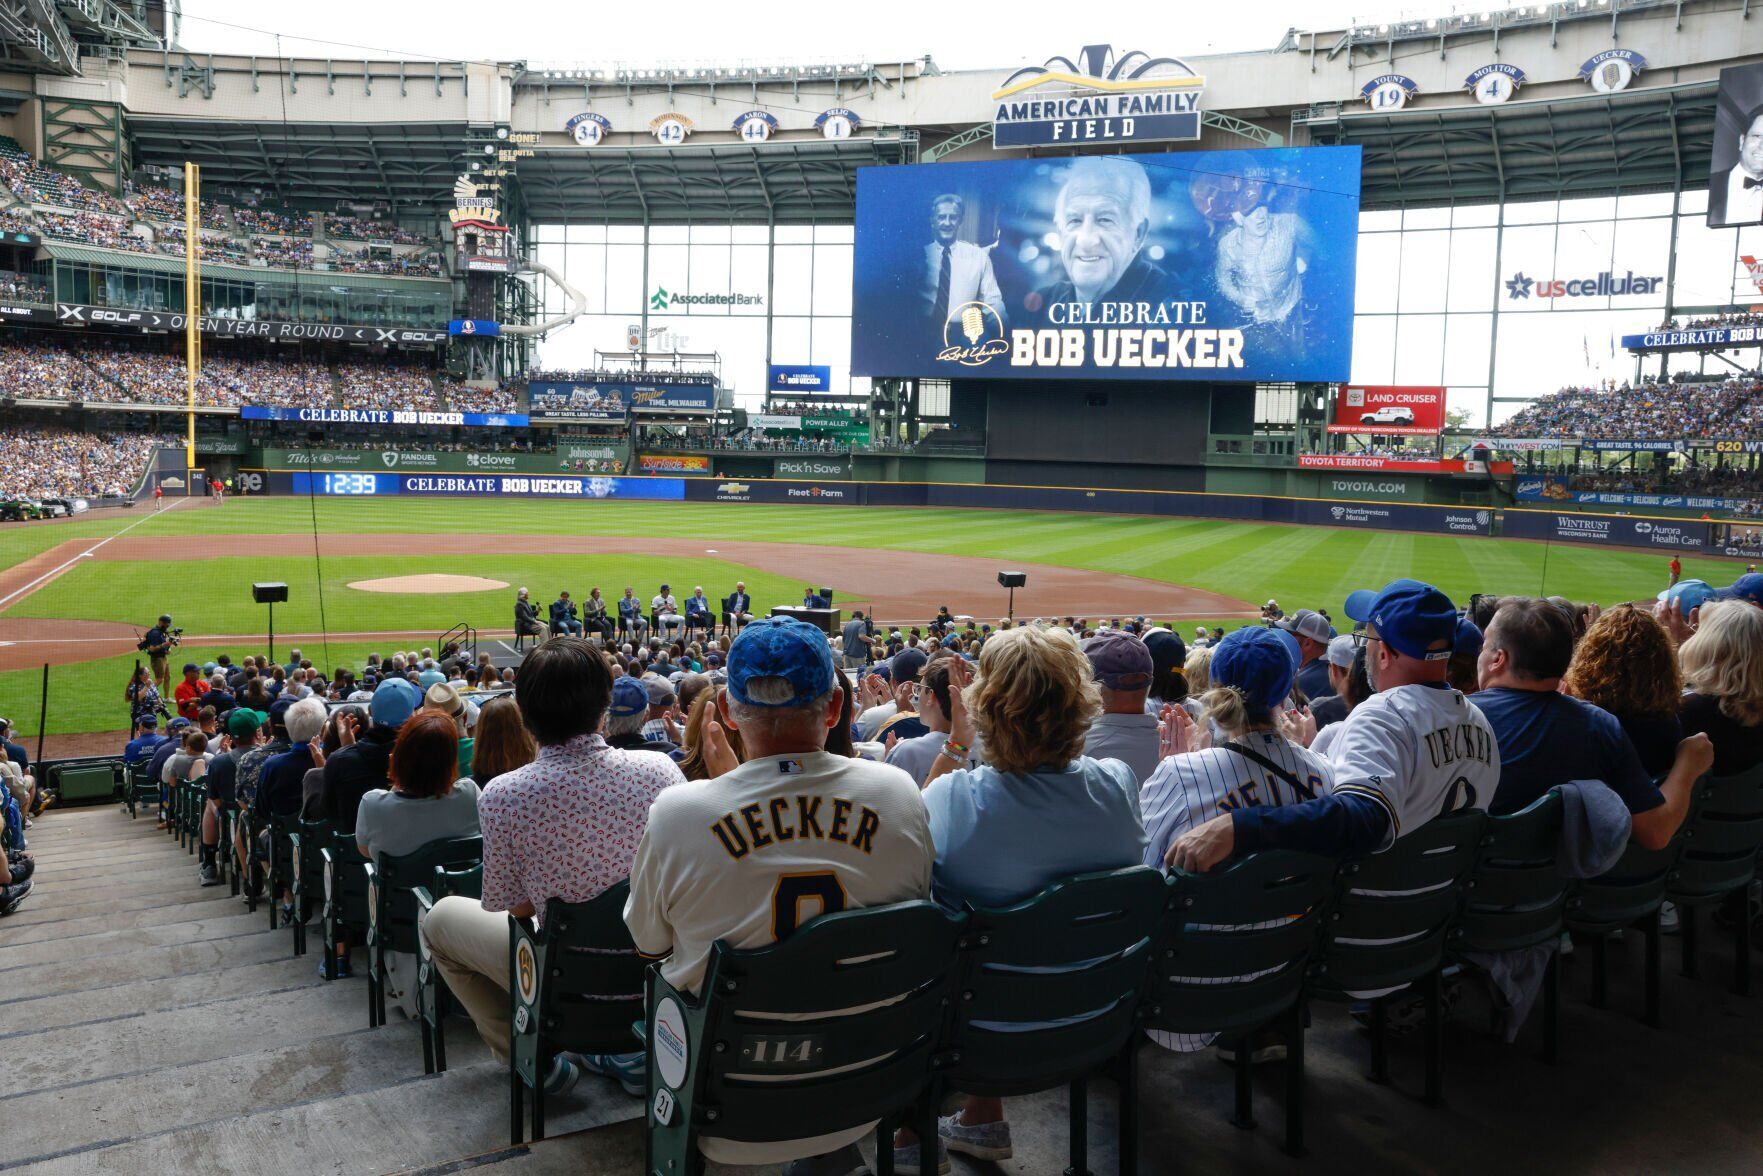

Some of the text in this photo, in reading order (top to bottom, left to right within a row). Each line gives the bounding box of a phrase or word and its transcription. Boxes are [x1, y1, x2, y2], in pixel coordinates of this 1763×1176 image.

[1592, 50, 1632, 64] UECKER
[1474, 64, 1518, 79] MOLITOR
[1374, 75, 1405, 86] YOUNT
[1486, 79, 1499, 97] 4
[1377, 89, 1400, 108] 19
[827, 108, 848, 117] SELIG
[996, 92, 1199, 121] AMERICAN FAMILY
[573, 113, 604, 123] FINGERS
[654, 112, 688, 123] ROBINSON
[744, 110, 768, 120] AARON
[578, 125, 598, 140] 34
[660, 125, 680, 140] 42
[744, 123, 765, 138] 44
[835, 122, 840, 136] 1
[1053, 118, 1135, 140] FIELD
[509, 134, 541, 143] GONE!
[1243, 167, 1272, 177] CENTRA
[456, 197, 493, 207] BERNIE'S
[448, 207, 500, 222] CHALET
[1535, 270, 1663, 298] uscellular
[1048, 300, 1207, 325] CELEBRATE
[91, 310, 141, 323] GOLF
[226, 320, 270, 335] YEAR
[280, 324, 343, 339] ROUND
[401, 331, 446, 342] GOLF
[1643, 330, 1725, 347] CELEBRATE
[1730, 328, 1754, 342] BOB
[1010, 328, 1244, 368] BOB UECKER
[632, 389, 667, 404] Miller
[649, 399, 667, 407] TIME,
[1367, 394, 1437, 403] LAND CRUISER
[300, 409, 464, 425] CELEBRATE BOB UECKER
[196, 441, 214, 451] rrel
[1716, 441, 1742, 452] 620
[287, 453, 318, 464] Tito's
[401, 453, 437, 461] FANDUEL
[480, 454, 516, 465] clover
[568, 447, 615, 459] Johnsonville
[643, 456, 683, 469] Surfside
[780, 461, 841, 474] Pick'n Save
[1300, 456, 1384, 467] TOYOTA TERRITORY
[325, 474, 376, 494] 12:39
[406, 478, 582, 494] CELEBRATE BOB UECKER
[1332, 480, 1406, 493] TOYOTA.COM
[1517, 481, 1546, 493] Culver's
[788, 488, 843, 497] Fleet Farm
[1599, 493, 1625, 504] WELCOME
[1633, 494, 1659, 505] DELICIOUS
[1687, 497, 1713, 508] WELCOME
[1346, 507, 1389, 517] Northwestern
[1346, 513, 1368, 522] Mutual
[1445, 514, 1472, 524] Johnson
[1558, 516, 1610, 530] WINTRUST
[1449, 522, 1477, 531] Controls
[1653, 524, 1680, 534] Aurora
[1558, 529, 1608, 539] WISCONSIN'S BANK
[1651, 533, 1701, 546] Health Care
[710, 795, 881, 861] UECKER
[751, 1040, 811, 1061] 114
[657, 1094, 669, 1119] 21
